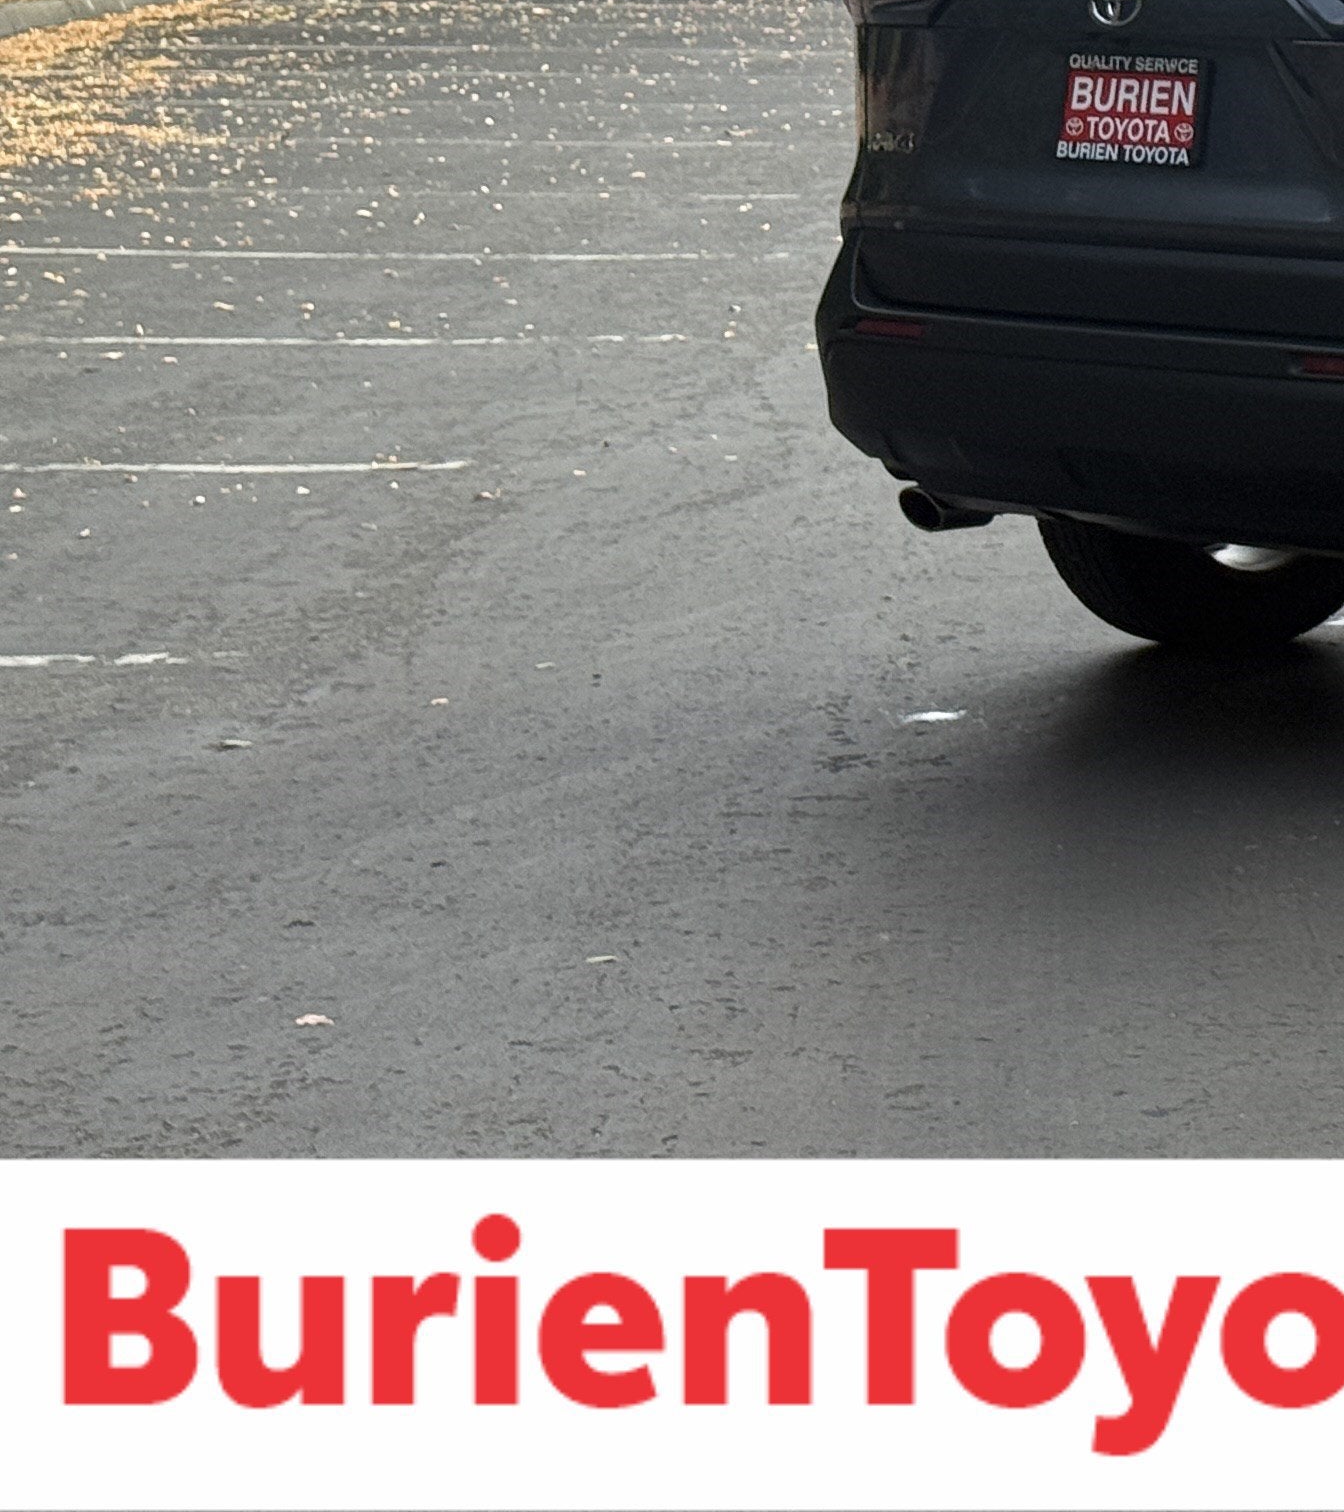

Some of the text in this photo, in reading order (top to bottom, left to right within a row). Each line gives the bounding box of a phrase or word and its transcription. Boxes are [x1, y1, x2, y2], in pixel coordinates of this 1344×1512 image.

[1069, 53, 1199, 74] QUALITY SERVICE
[1071, 76, 1197, 116] BURIEN
[1086, 116, 1171, 144] TOYOTA
[1056, 140, 1190, 167] BURIEN TOYOTA
